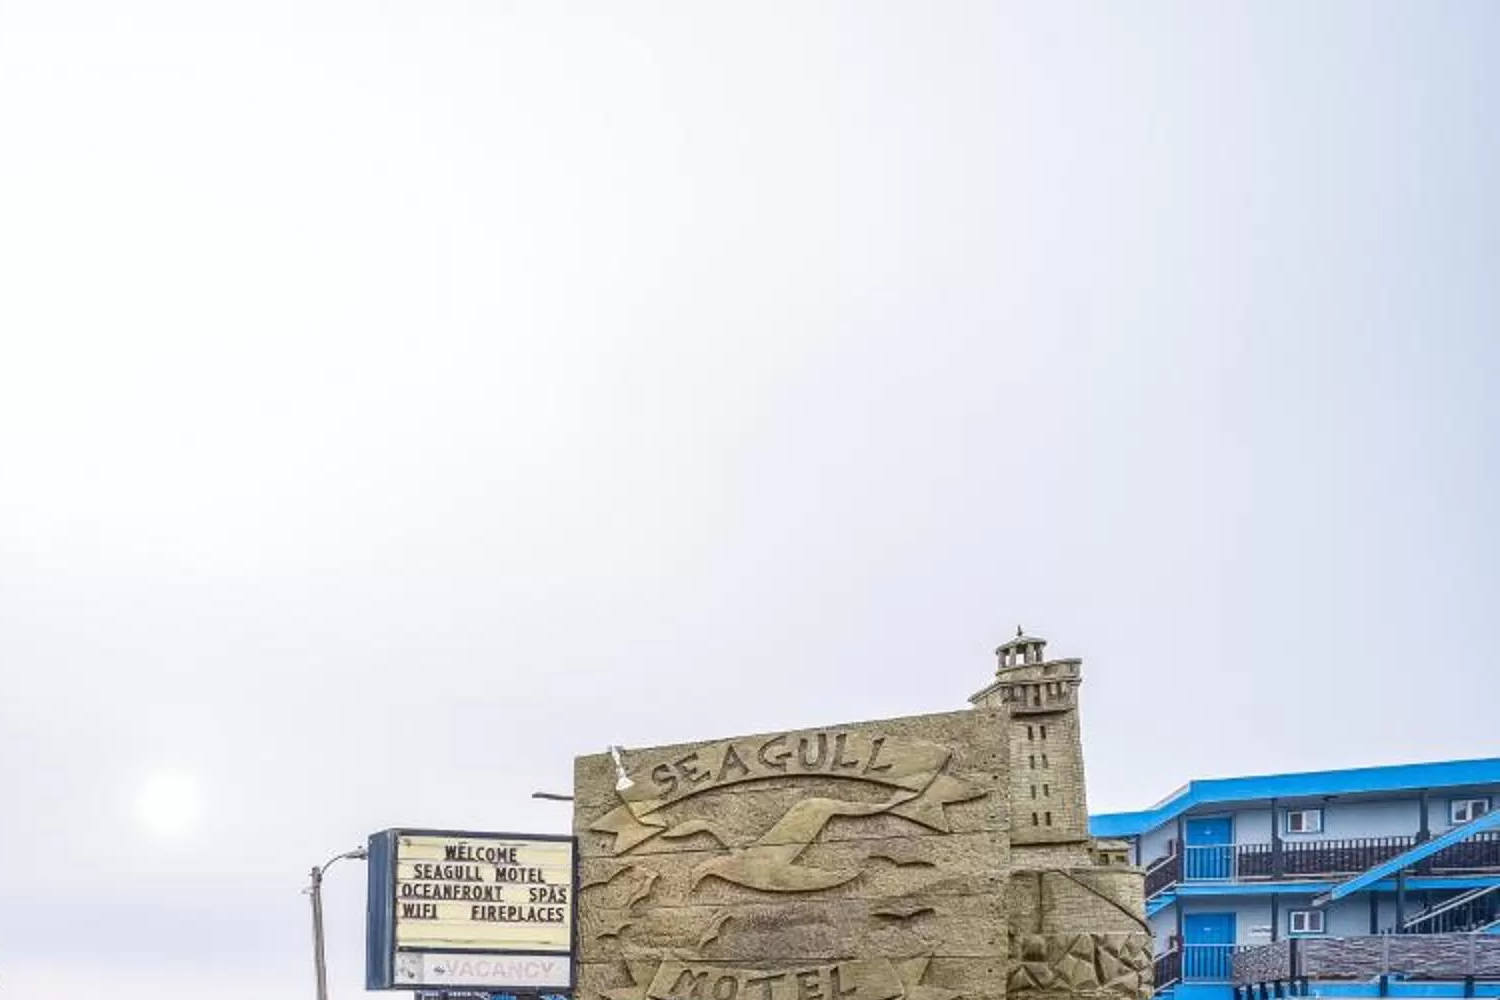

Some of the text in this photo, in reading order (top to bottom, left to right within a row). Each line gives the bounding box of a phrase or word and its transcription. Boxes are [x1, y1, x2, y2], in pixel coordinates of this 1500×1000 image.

[651, 732, 893, 800] SEAGULL
[444, 845, 518, 864] WELCOME
[413, 863, 546, 884] SEAGULL MOTEL
[402, 883, 568, 904] OCEANFRONT SPAS
[402, 903, 565, 923] WIFI FIREPLACES
[446, 958, 557, 981] VACANCY
